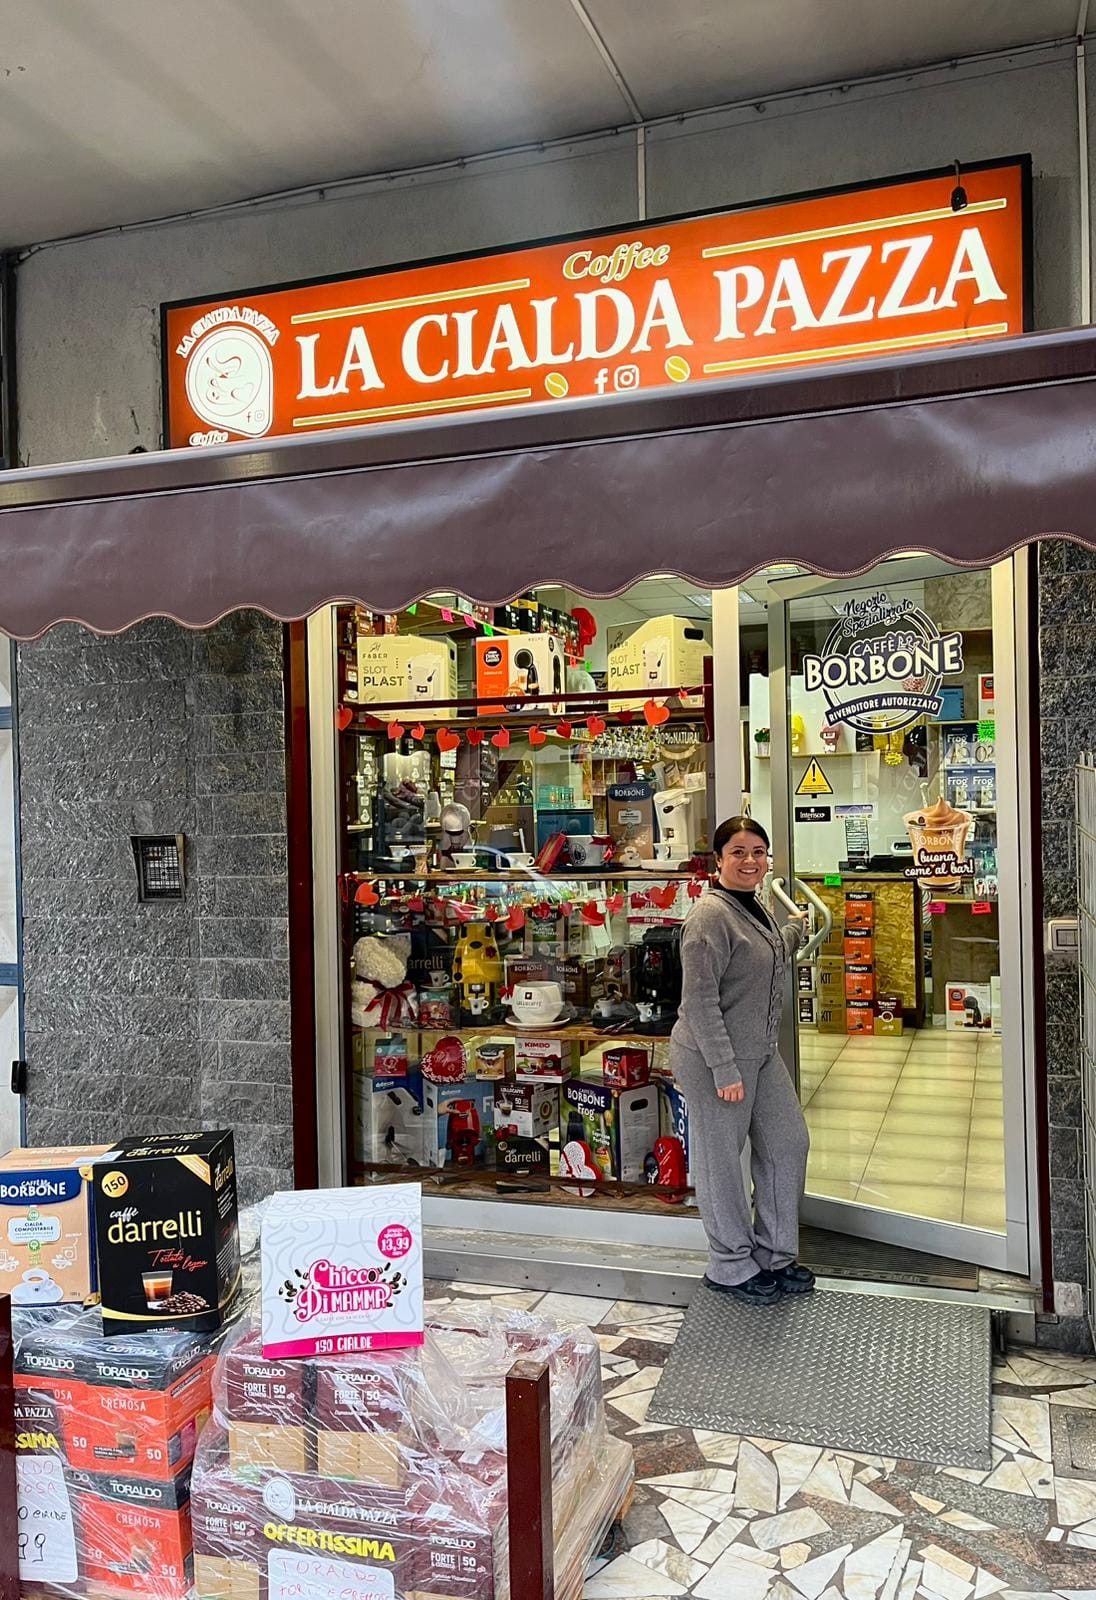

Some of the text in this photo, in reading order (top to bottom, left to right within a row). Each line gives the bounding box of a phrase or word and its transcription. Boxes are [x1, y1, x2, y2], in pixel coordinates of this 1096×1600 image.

[563, 241, 670, 283] Coffee
[296, 228, 1007, 400] LA CIALDA PAZZA
[176, 306, 280, 358] LA CIALDA PAZZA
[189, 430, 229, 446] Coffee
[843, 592, 887, 616] Negozio
[843, 598, 914, 637] Specializzato
[853, 637, 896, 657] CAFFÈ
[611, 655, 628, 665] SLOT
[804, 636, 962, 690] BORBONE
[363, 666, 388, 674] SLOT
[611, 663, 640, 678] PLAST
[363, 676, 404, 687] PLAST
[829, 697, 939, 723] RIVENDITORE AUTORIZZATO
[948, 776, 968, 788] Frog
[972, 776, 994, 788] Frog
[614, 788, 645, 798] BORBONE
[920, 850, 956, 863] buona
[904, 859, 974, 876] come al bar!
[409, 956, 444, 969] arrelli
[821, 973, 832, 984] KIT
[821, 1011, 832, 1021] KIT
[567, 1087, 605, 1108] BORBONE
[577, 1103, 595, 1121] Frog
[126, 1145, 190, 1157] darrelli
[504, 1151, 541, 1163] darrelli
[0, 1181, 66, 1198] BORBONE
[105, 1176, 126, 1194] 150
[109, 1206, 139, 1224] caffè
[107, 1210, 202, 1244] darrelli
[309, 1260, 379, 1289] Chicco
[331, 1287, 391, 1312] MAMMA
[315, 1336, 373, 1353] 150 CIALDE
[24, 1356, 75, 1369] TORALDO
[96, 1365, 149, 1379] TORALDO
[243, 1366, 286, 1377] TORALDO
[335, 1374, 380, 1383] TORALDO
[244, 1382, 286, 1394] FORTE 50
[367, 1391, 380, 1400] 50
[101, 1397, 146, 1412] CREMOSA
[25, 1407, 54, 1418] PAZZA
[72, 1436, 87, 1448] 50
[146, 1449, 162, 1460] 50
[110, 1482, 162, 1498] TORALDO
[205, 1499, 246, 1513] TORALDO
[299, 1499, 398, 1525] LA CIALDA PAZZA
[116, 1512, 161, 1529] CREMOSA
[234, 1520, 246, 1531] 50
[263, 1522, 395, 1561] OFFERTISSIMA
[431, 1535, 476, 1548] TORALDO
[431, 1552, 476, 1567] FORTE 50
[161, 1565, 176, 1576] 50
[276, 1557, 377, 1582] TORALDO
